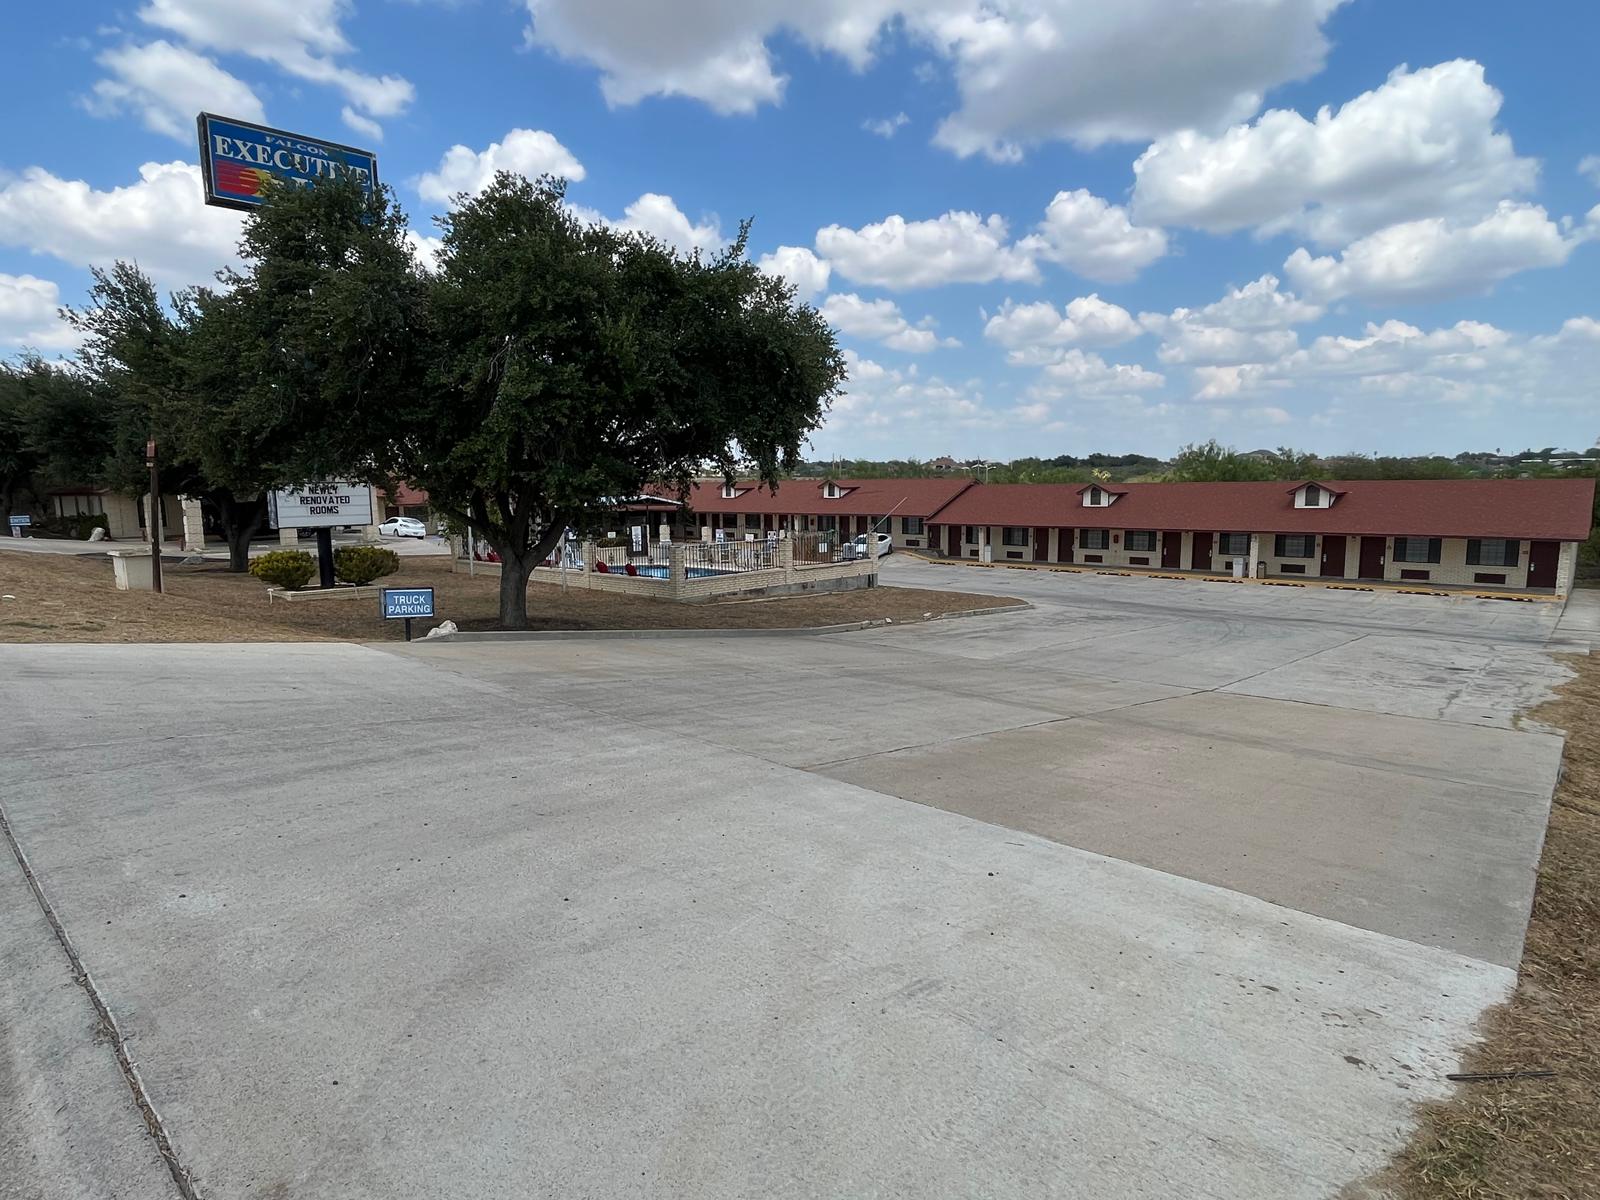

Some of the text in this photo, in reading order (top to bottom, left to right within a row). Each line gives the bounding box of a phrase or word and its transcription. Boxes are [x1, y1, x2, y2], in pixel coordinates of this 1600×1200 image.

[265, 136, 328, 156] FALCON
[213, 134, 370, 186] EXECUTIVE
[308, 484, 338, 495] NEWLY
[300, 495, 350, 505] RENOVATED
[309, 506, 339, 515] ROOMS
[393, 595, 426, 604] TRUCK
[388, 604, 431, 614] PARKING
